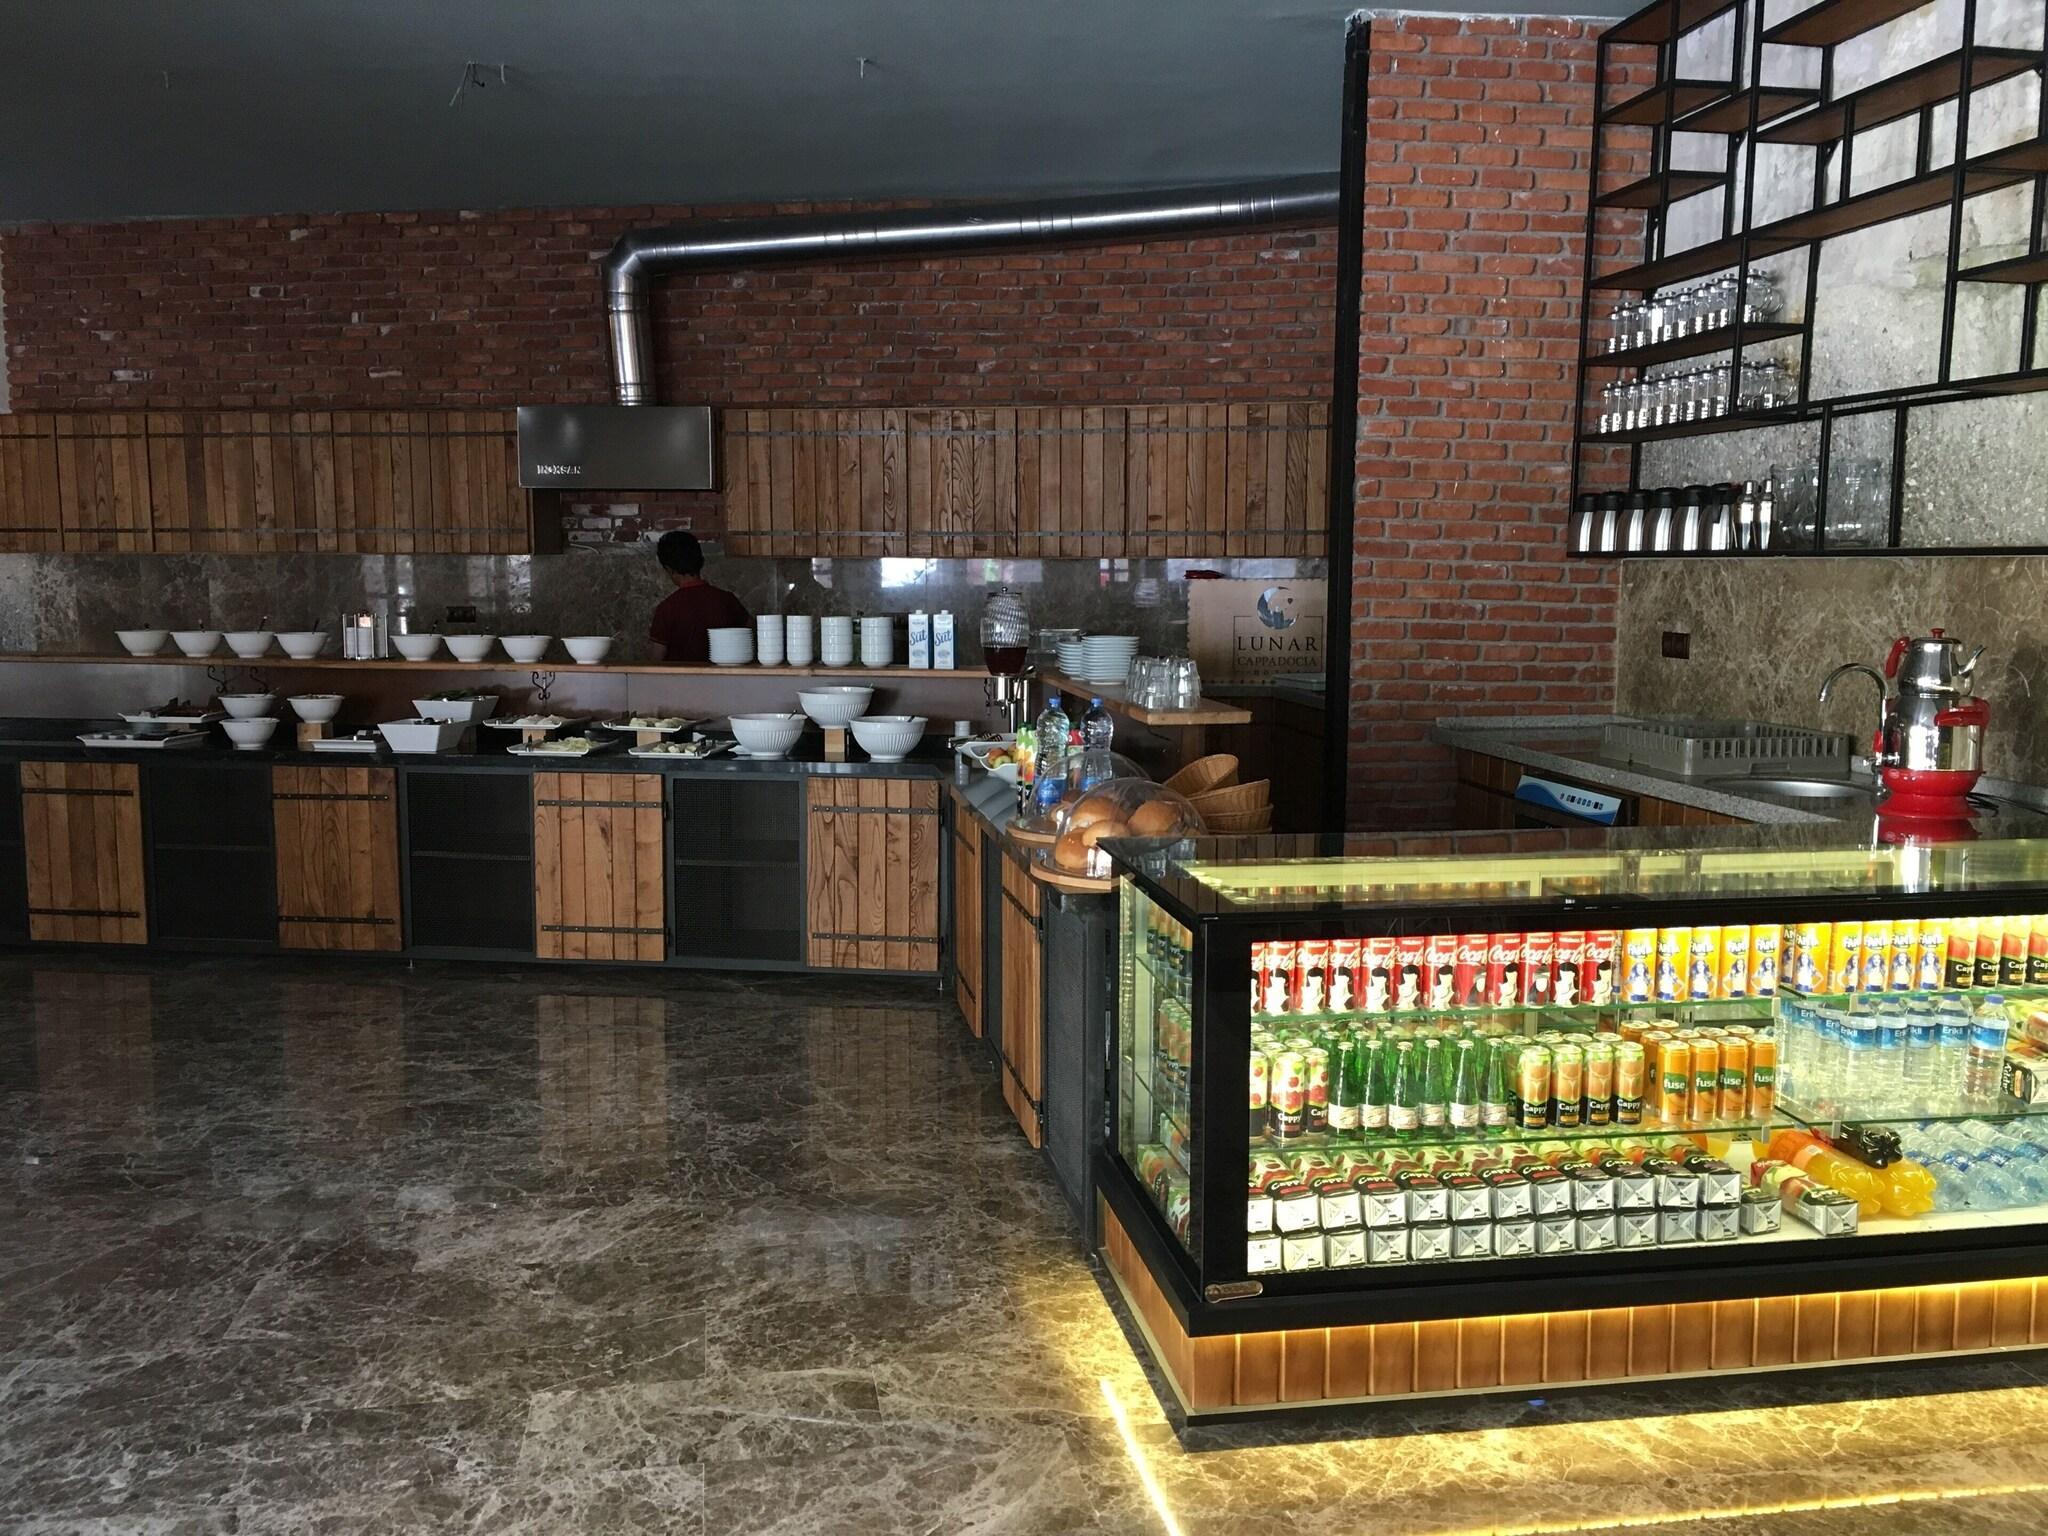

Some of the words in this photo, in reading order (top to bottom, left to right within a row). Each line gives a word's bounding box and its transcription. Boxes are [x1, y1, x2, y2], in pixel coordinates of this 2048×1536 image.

[1237, 636, 1318, 651] LUNAR
[1237, 655, 1317, 667] CAPPADOCIA
[1696, 1077, 1717, 1088] fuse
[1720, 1075, 1742, 1085] fuse
[1754, 1073, 1775, 1083] fuse
[1663, 1079, 1686, 1089] fuse
[1523, 1103, 1546, 1115] Cappy
[1617, 1099, 1641, 1110] Cappy
